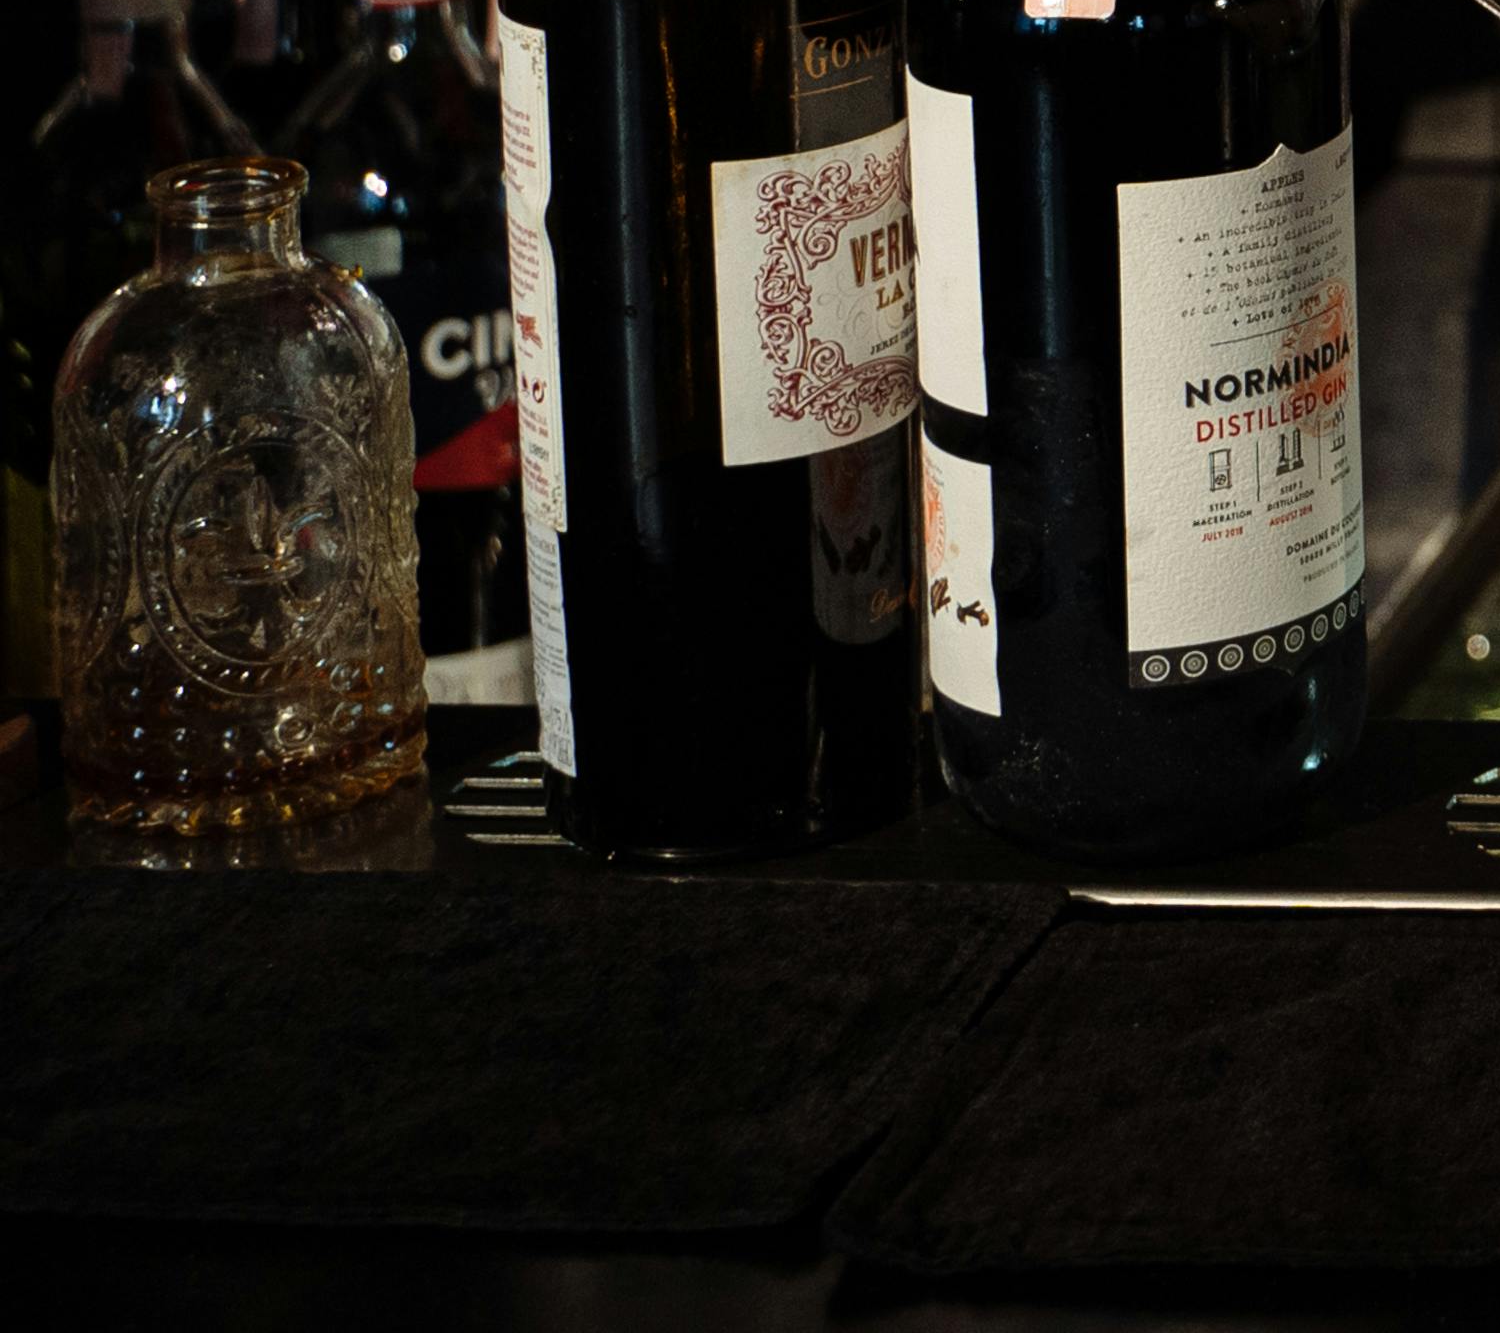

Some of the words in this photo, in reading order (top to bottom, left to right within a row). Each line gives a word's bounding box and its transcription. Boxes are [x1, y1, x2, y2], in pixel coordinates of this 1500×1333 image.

[1261, 169, 1305, 193] APPLES
[1219, 215, 1287, 239] incredible
[1238, 235, 1278, 253] family
[1226, 249, 1288, 274] botanical
[876, 279, 905, 311] LA
[1219, 281, 1240, 293] The
[1185, 331, 1350, 409] NORMINDIA
[1196, 391, 1317, 443] DISTILLED
[1322, 373, 1347, 406] GIN
[1209, 501, 1231, 513] STEP
[1266, 489, 1315, 512] DISTILLATION
[1192, 509, 1252, 527] MACERATION
[1269, 508, 1297, 527] AUGUST
[1202, 528, 1222, 543] JULY
[1286, 528, 1329, 556] DOMAINE
